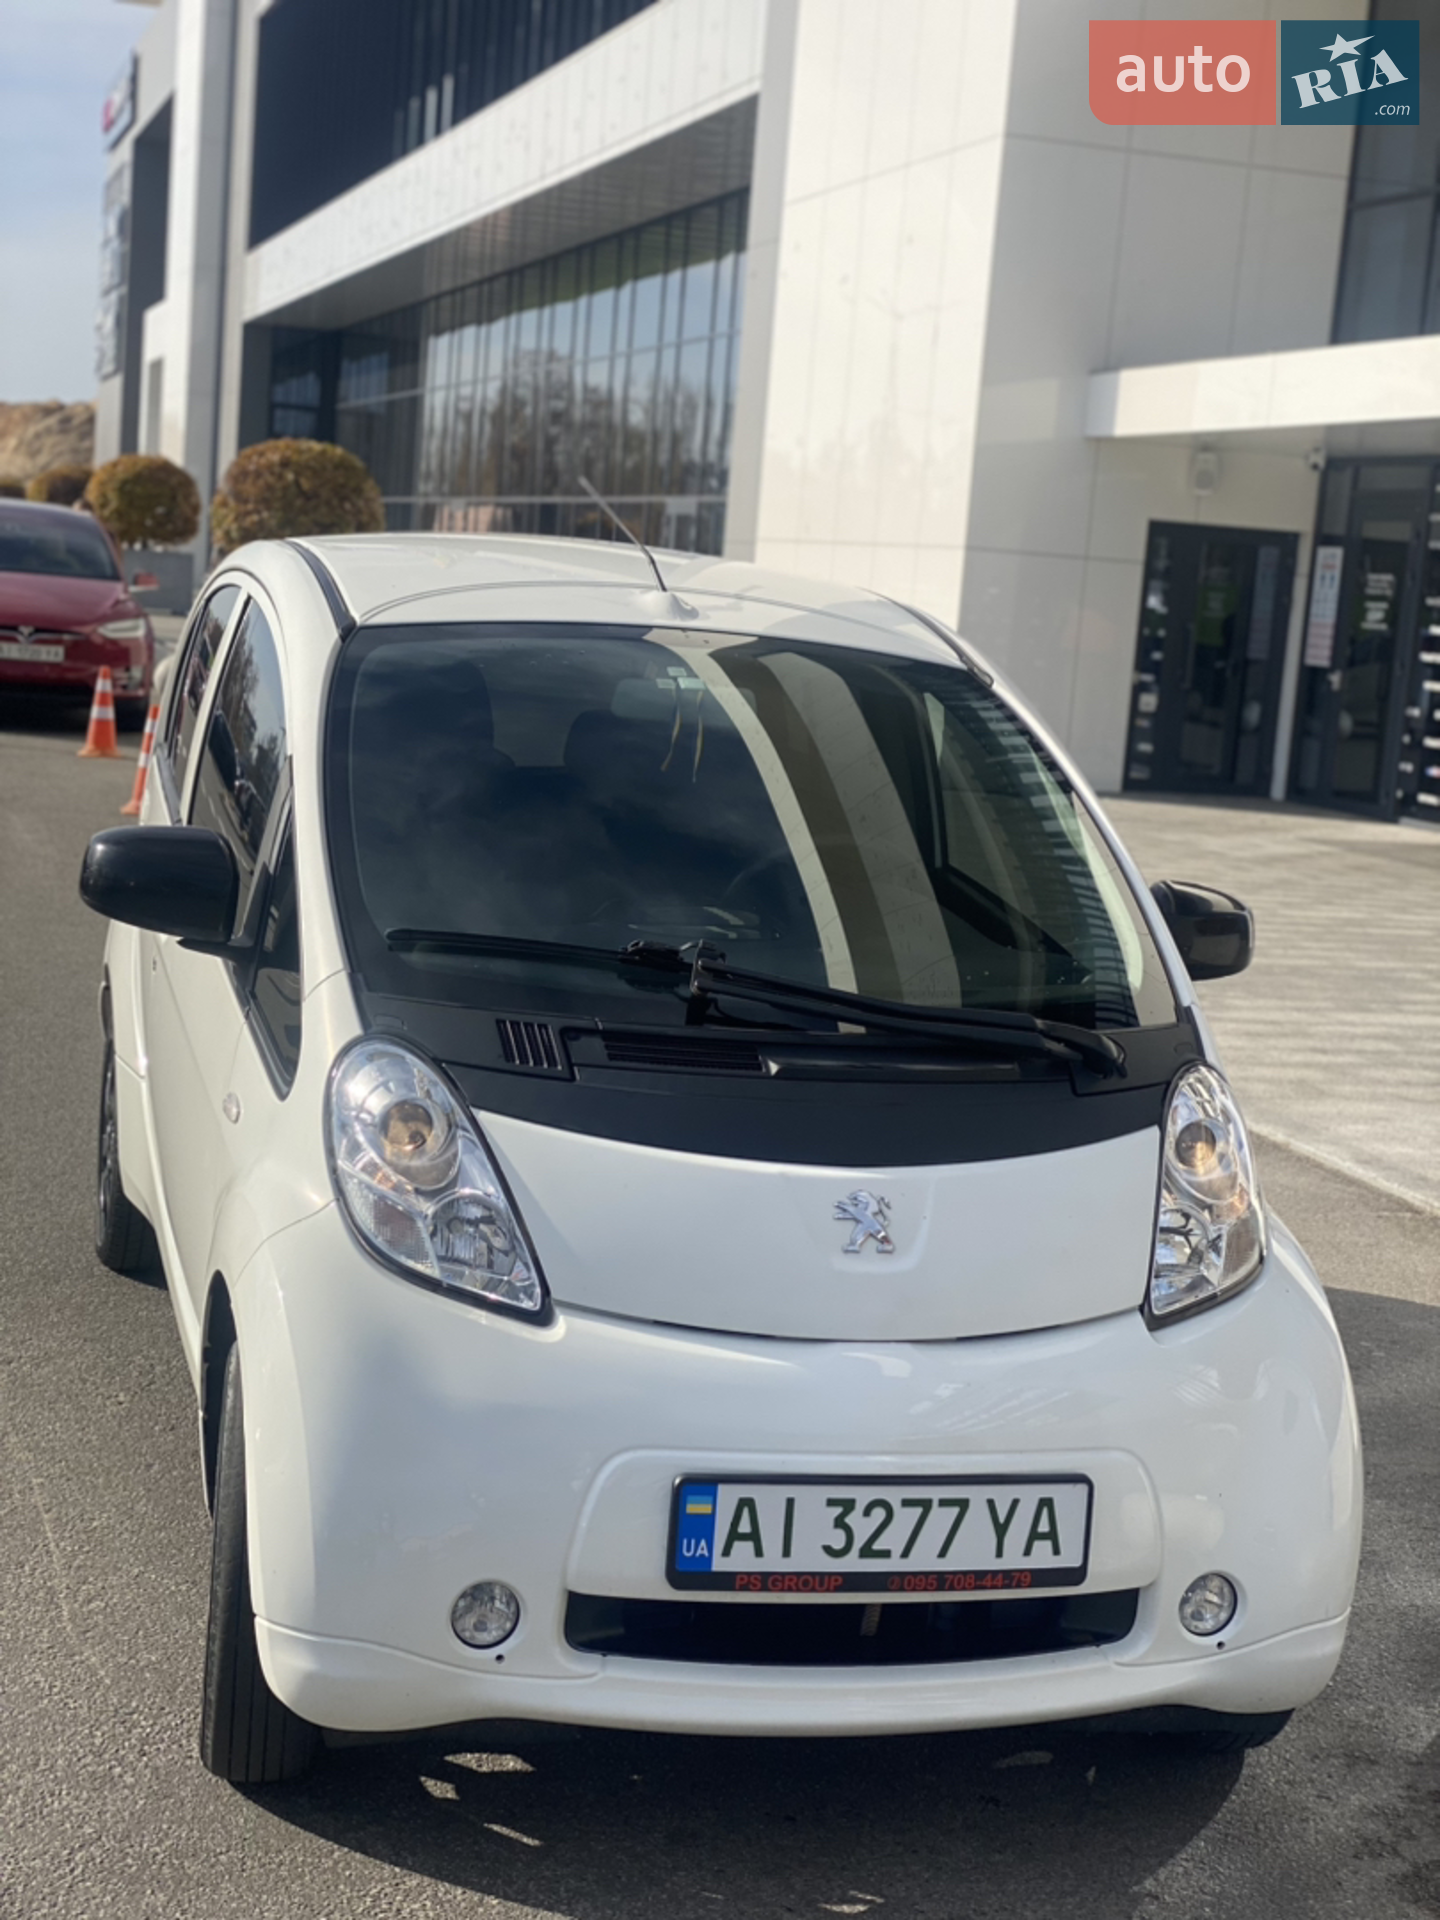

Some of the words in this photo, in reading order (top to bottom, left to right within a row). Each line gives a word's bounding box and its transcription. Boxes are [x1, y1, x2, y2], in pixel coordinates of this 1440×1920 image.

[720, 1496, 796, 1559] AI
[821, 1496, 971, 1559] 3277
[986, 1496, 1062, 1558] YA
[682, 1538, 709, 1558] UA
[735, 1574, 762, 1590] PS
[767, 1574, 843, 1592] GROUP
[903, 1573, 938, 1591] 095
[944, 1571, 1032, 1590] 708-44-79
